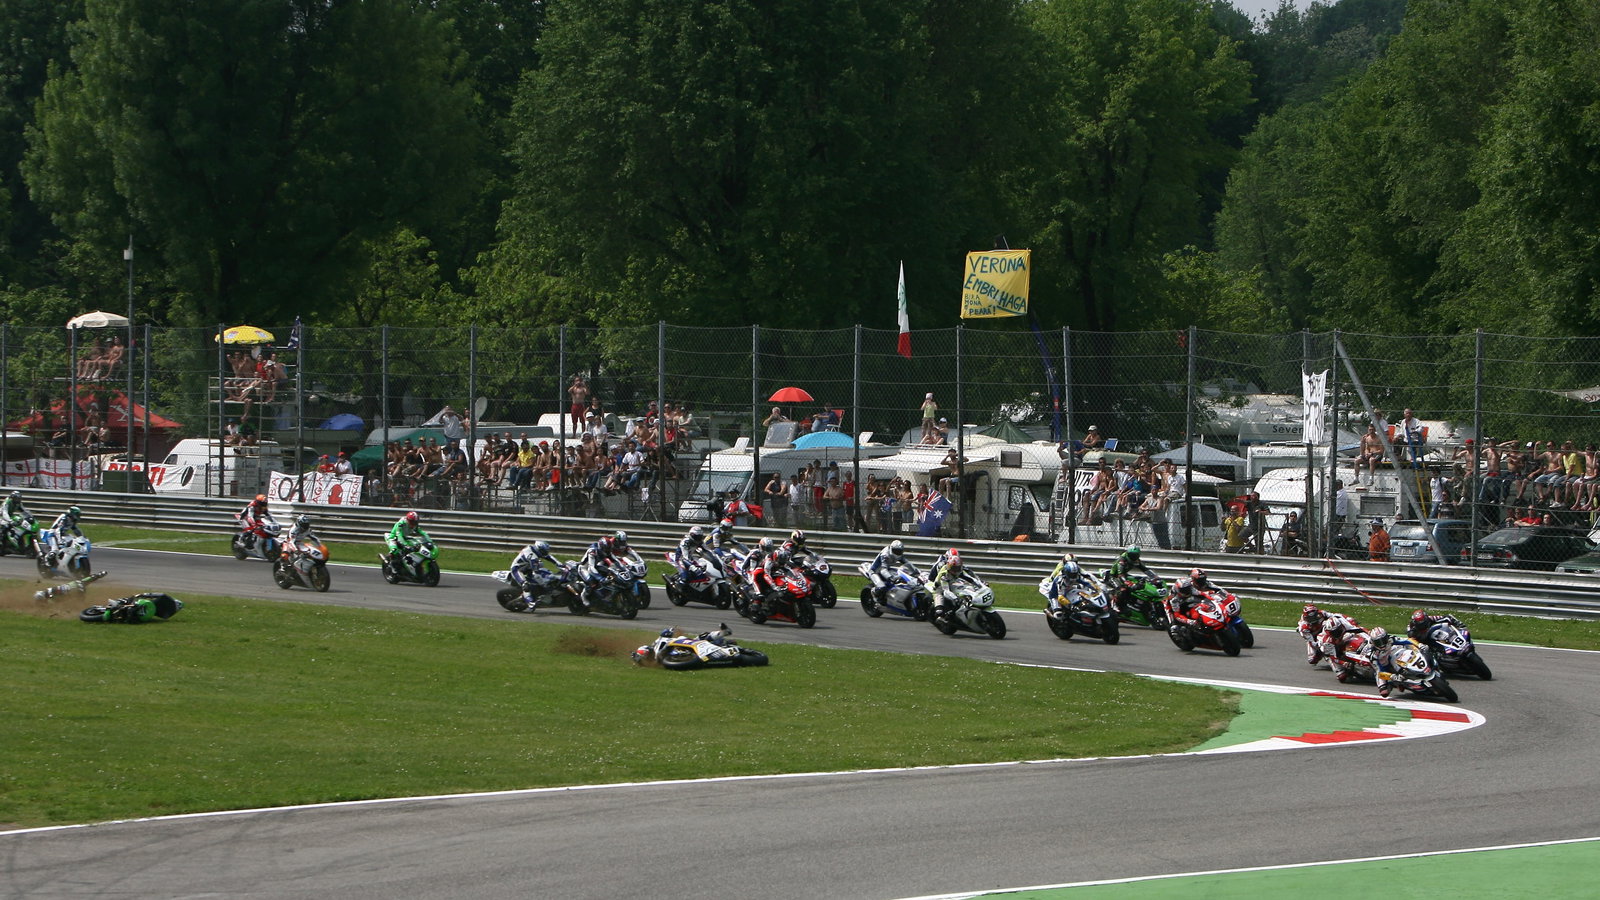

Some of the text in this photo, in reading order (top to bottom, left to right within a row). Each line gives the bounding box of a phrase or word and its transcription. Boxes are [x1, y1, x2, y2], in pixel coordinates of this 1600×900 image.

[969, 256, 1026, 273] VERONA
[964, 273, 1027, 312] EMBRI HAGA
[982, 593, 992, 603] 65
[1228, 602, 1237, 613] 9
[1213, 610, 1222, 620] 3
[1451, 636, 1465, 649] 19
